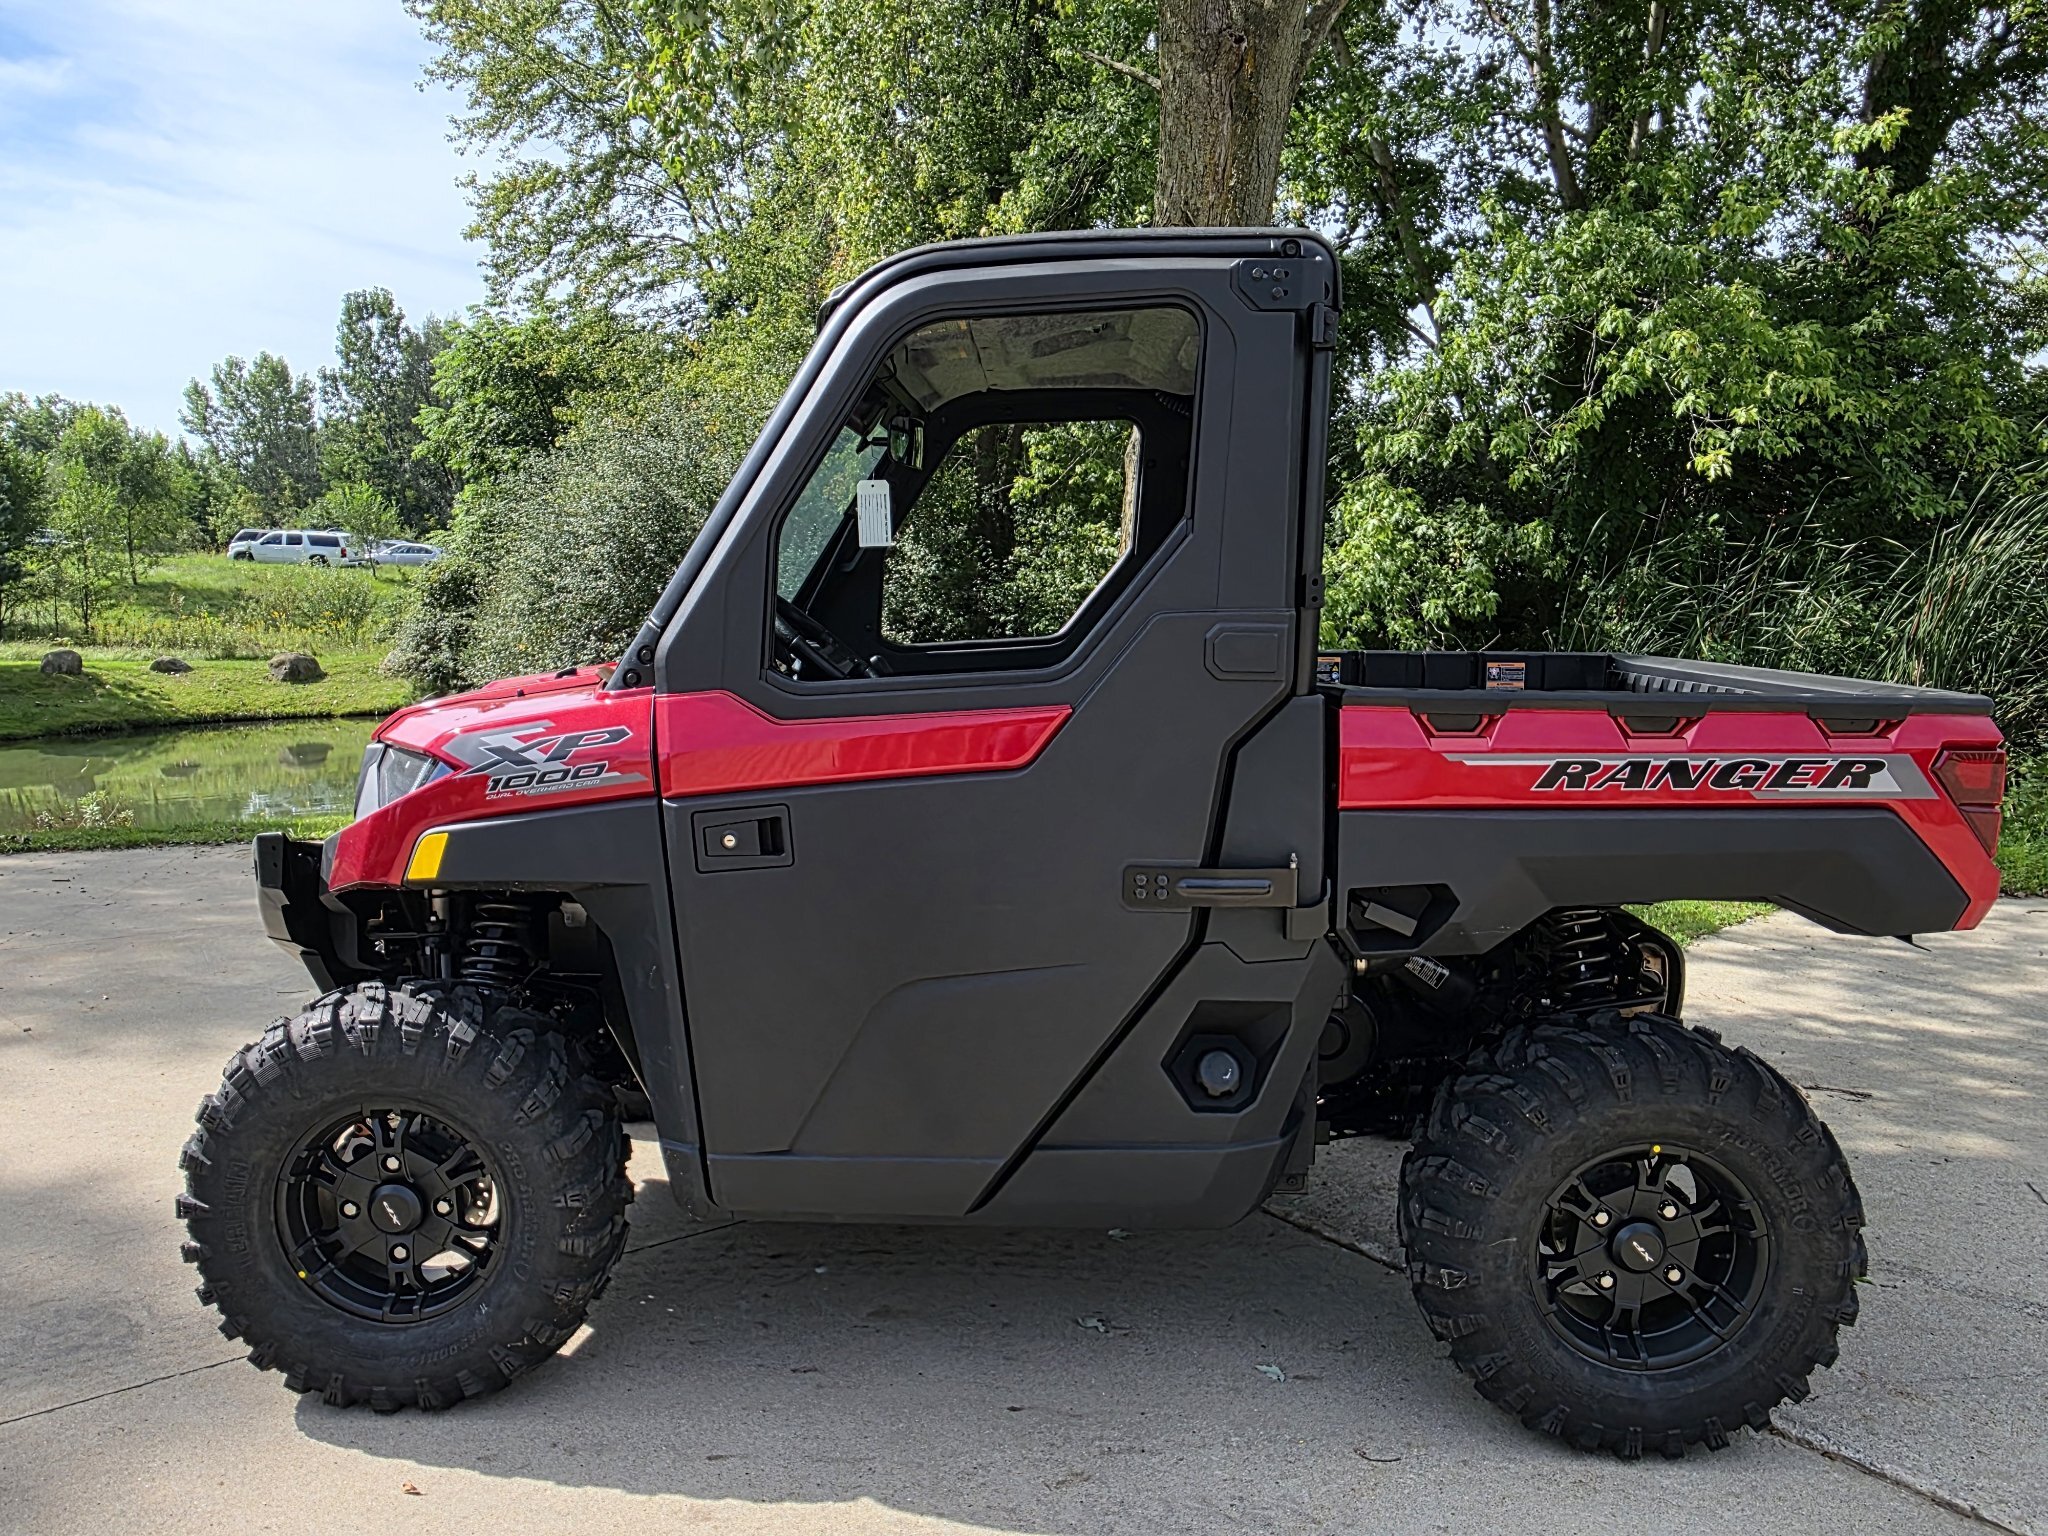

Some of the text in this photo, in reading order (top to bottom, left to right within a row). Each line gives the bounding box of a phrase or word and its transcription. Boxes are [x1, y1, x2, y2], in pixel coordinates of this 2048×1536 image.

[455, 726, 632, 778] XP
[486, 780, 599, 800] DUAL OVERHEAD CAM
[487, 762, 608, 794] 1000
[1531, 758, 1887, 792] RANGER
